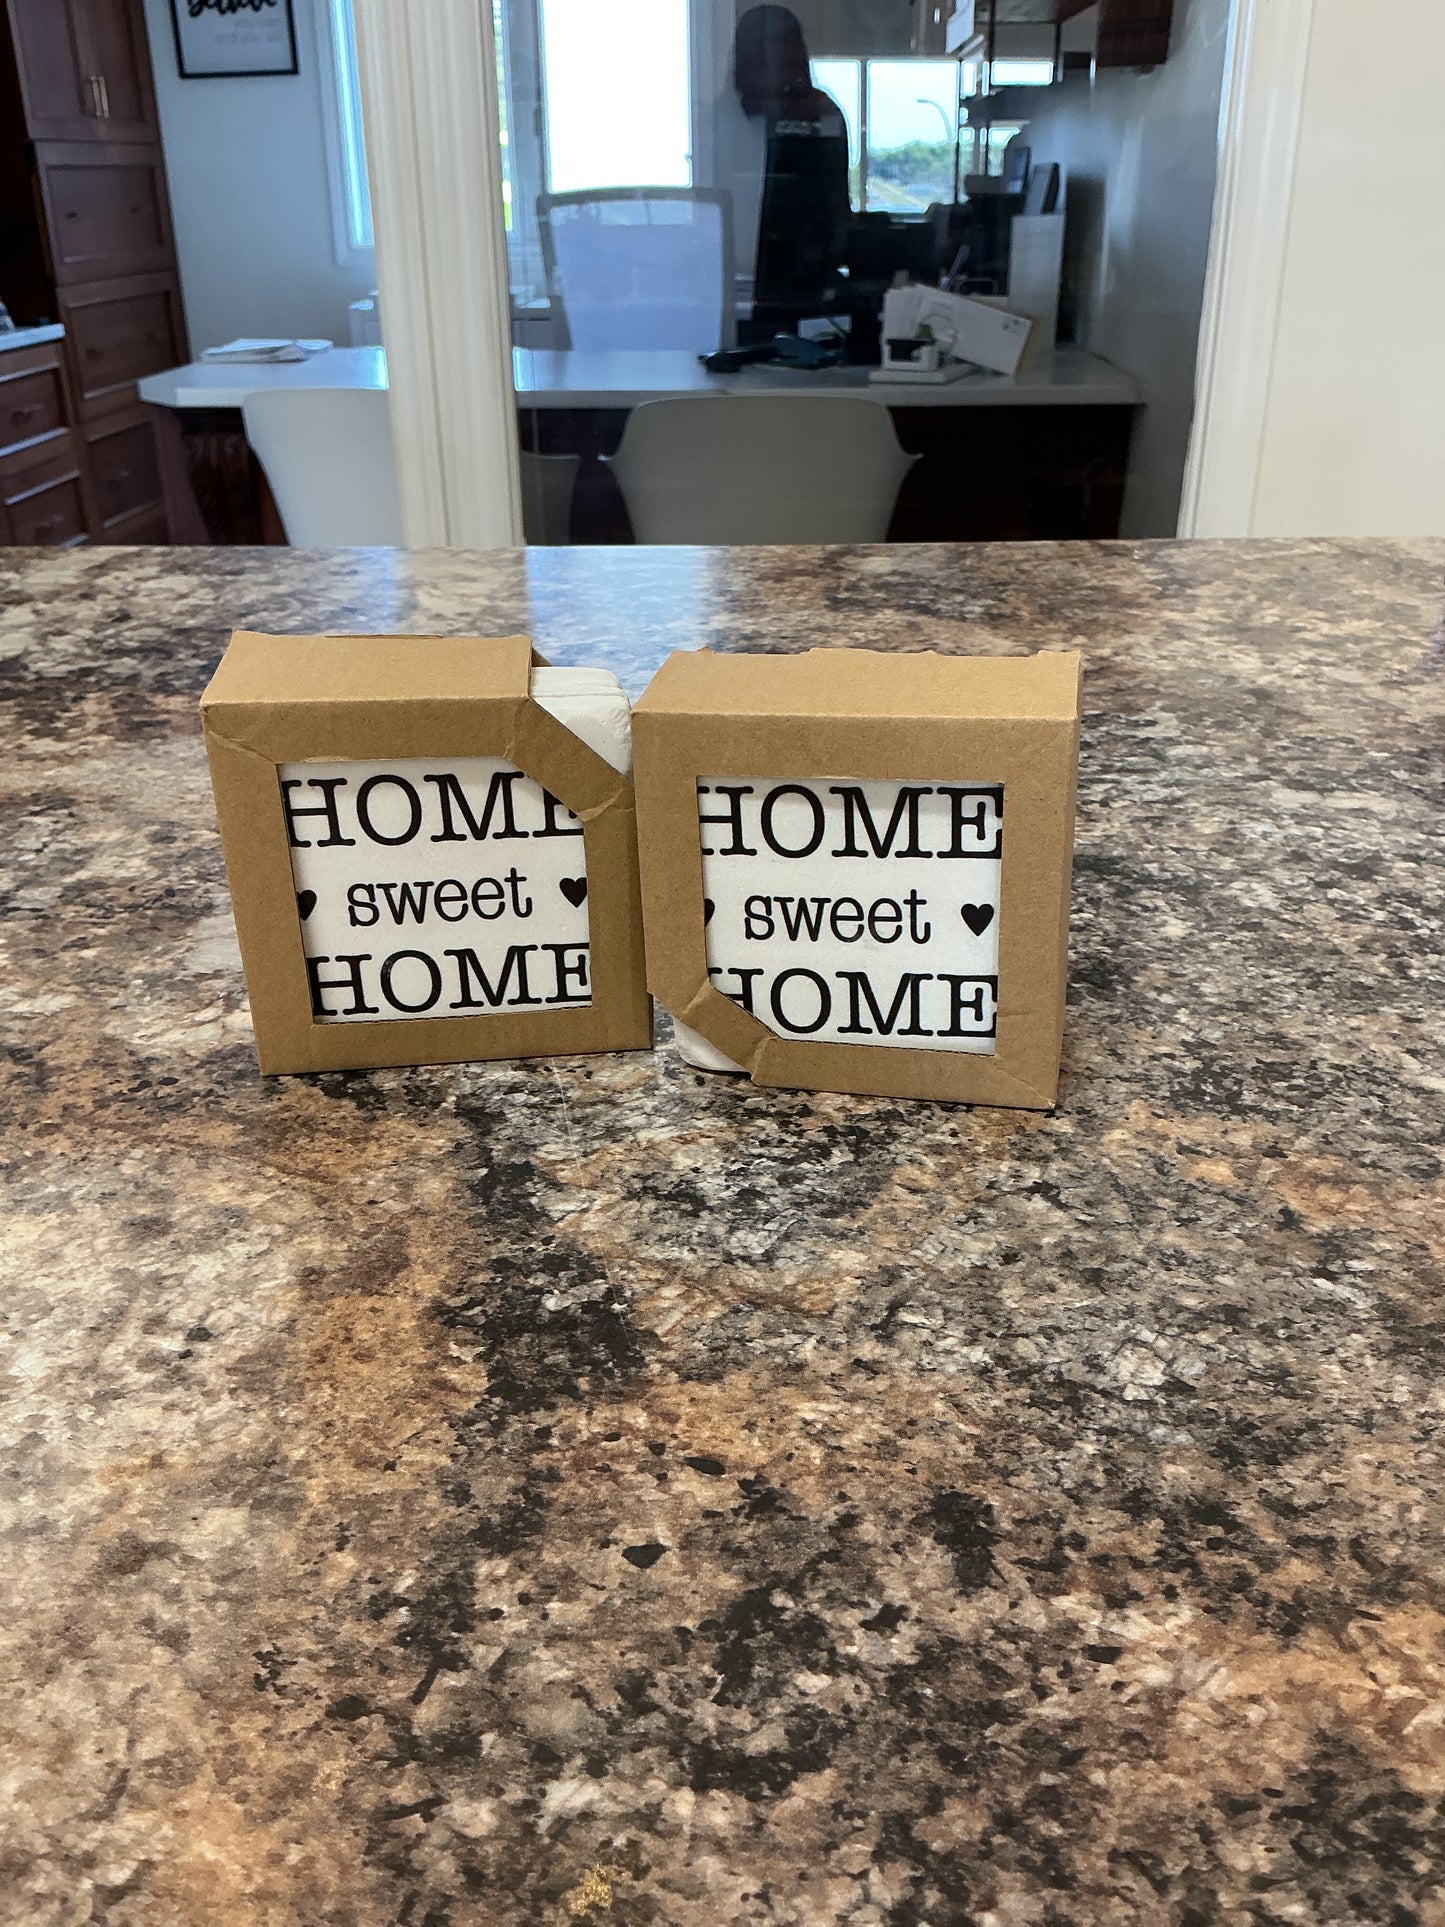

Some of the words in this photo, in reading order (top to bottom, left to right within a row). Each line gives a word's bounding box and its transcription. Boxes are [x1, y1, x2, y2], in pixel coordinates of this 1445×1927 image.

[347, 868, 533, 927] sweet
[744, 889, 931, 944] sweet
[307, 943, 593, 1017] HOME
